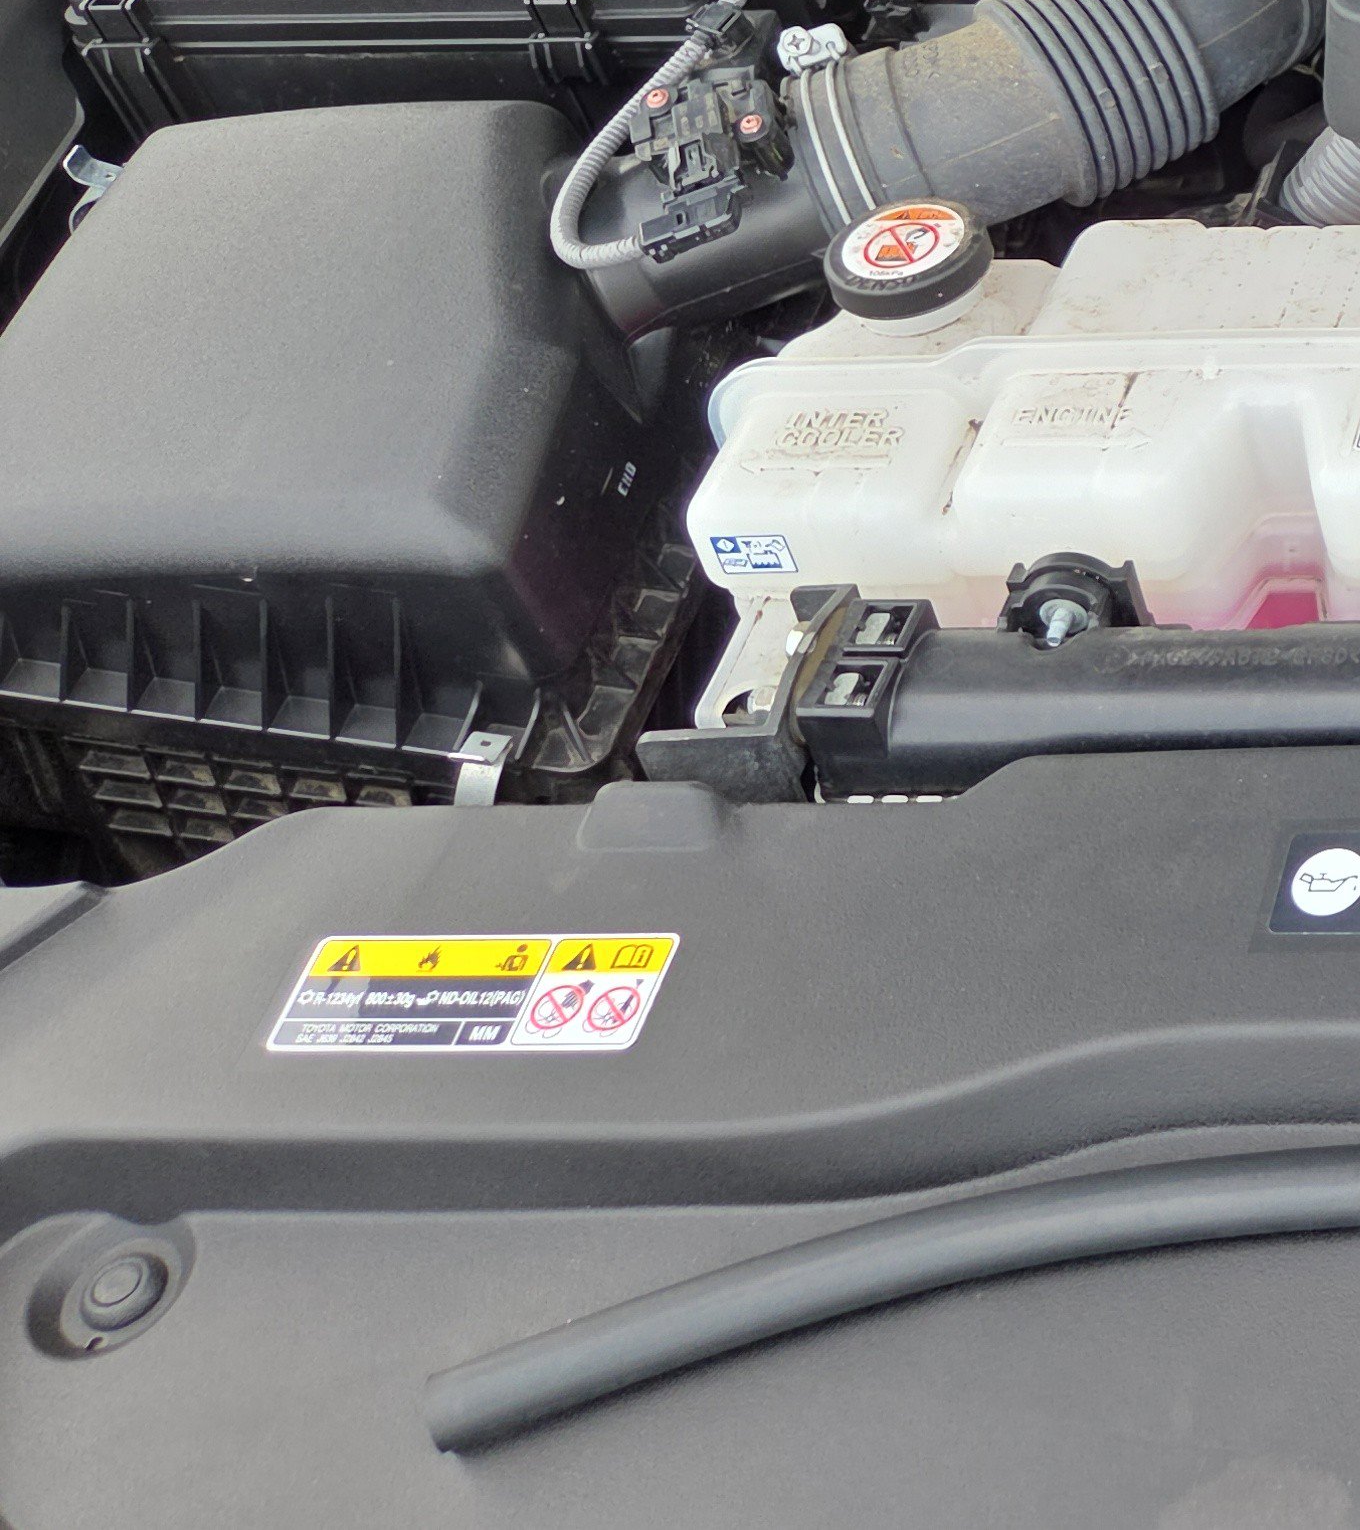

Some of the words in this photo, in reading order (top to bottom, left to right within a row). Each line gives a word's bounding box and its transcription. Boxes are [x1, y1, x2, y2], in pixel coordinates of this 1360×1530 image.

[784, 407, 890, 428] INTER
[1013, 406, 1139, 426] ENGINE
[775, 427, 905, 448] COOLER
[302, 1023, 337, 1034] TOYOTA
[340, 1023, 372, 1034] MOTOR
[374, 1023, 440, 1034] CORPORATION
[468, 1025, 503, 1041] MM
